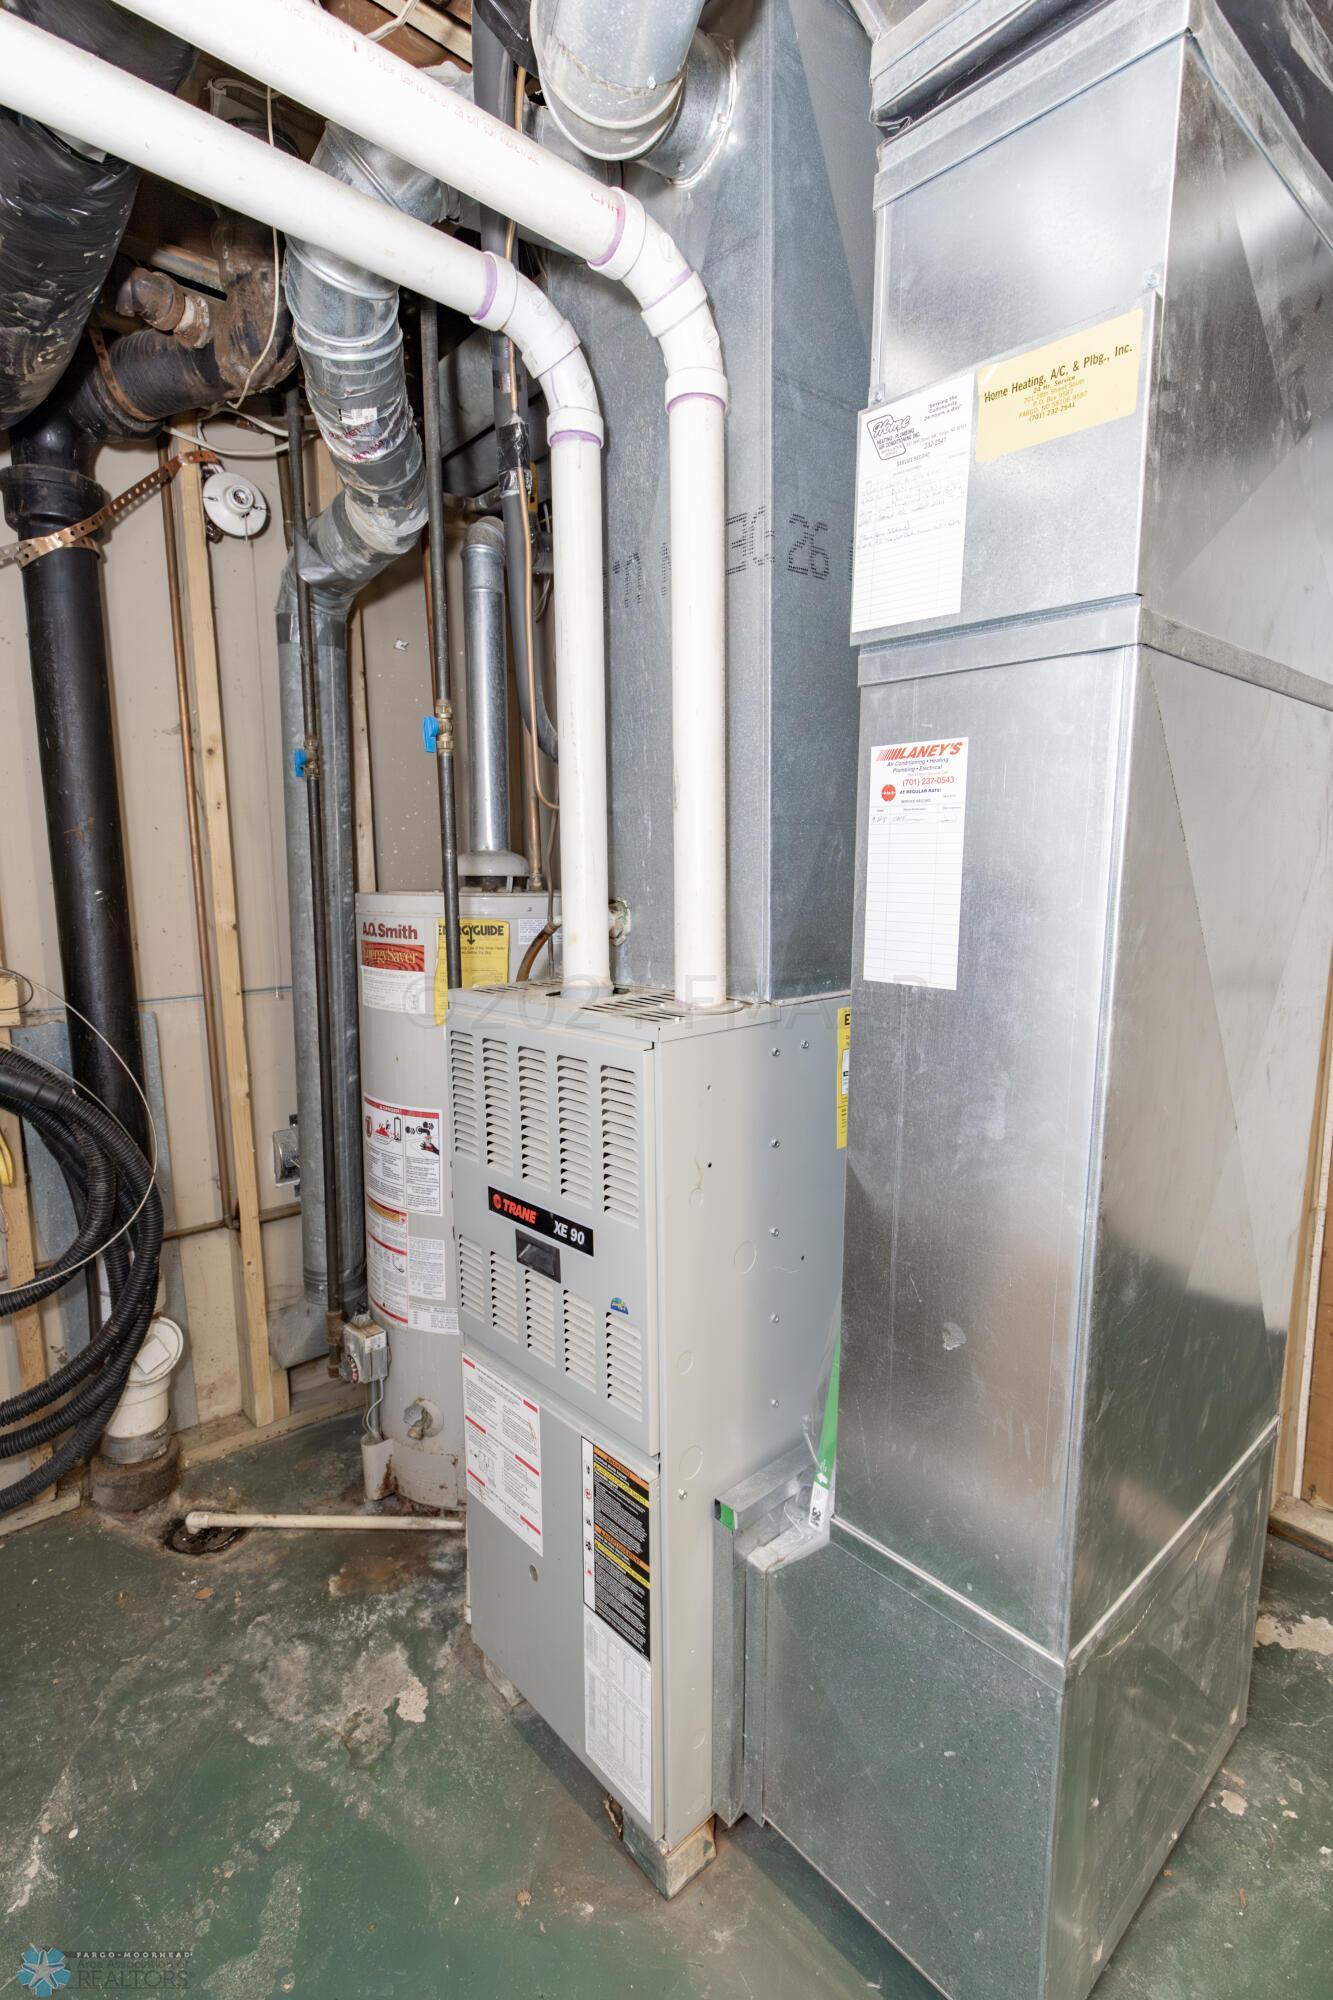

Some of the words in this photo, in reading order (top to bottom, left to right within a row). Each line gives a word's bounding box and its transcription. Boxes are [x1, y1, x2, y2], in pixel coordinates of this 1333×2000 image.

[984, 386, 1008, 403] Home
[1011, 375, 1047, 394] Heating,
[1050, 365, 1069, 380] A/C,
[1072, 360, 1080, 372] &
[1114, 344, 1133, 357] Inc.
[1054, 375, 1076, 387] Service
[1029, 410, 1045, 422] (701)
[897, 742, 964, 760] LANEY'S
[902, 778, 920, 787] (701)
[921, 775, 955, 785] 237-0543
[377, 922, 418, 940] Smith
[502, 1198, 537, 1224] TRANE
[553, 1221, 568, 1238] XE
[570, 1228, 584, 1245] 90
